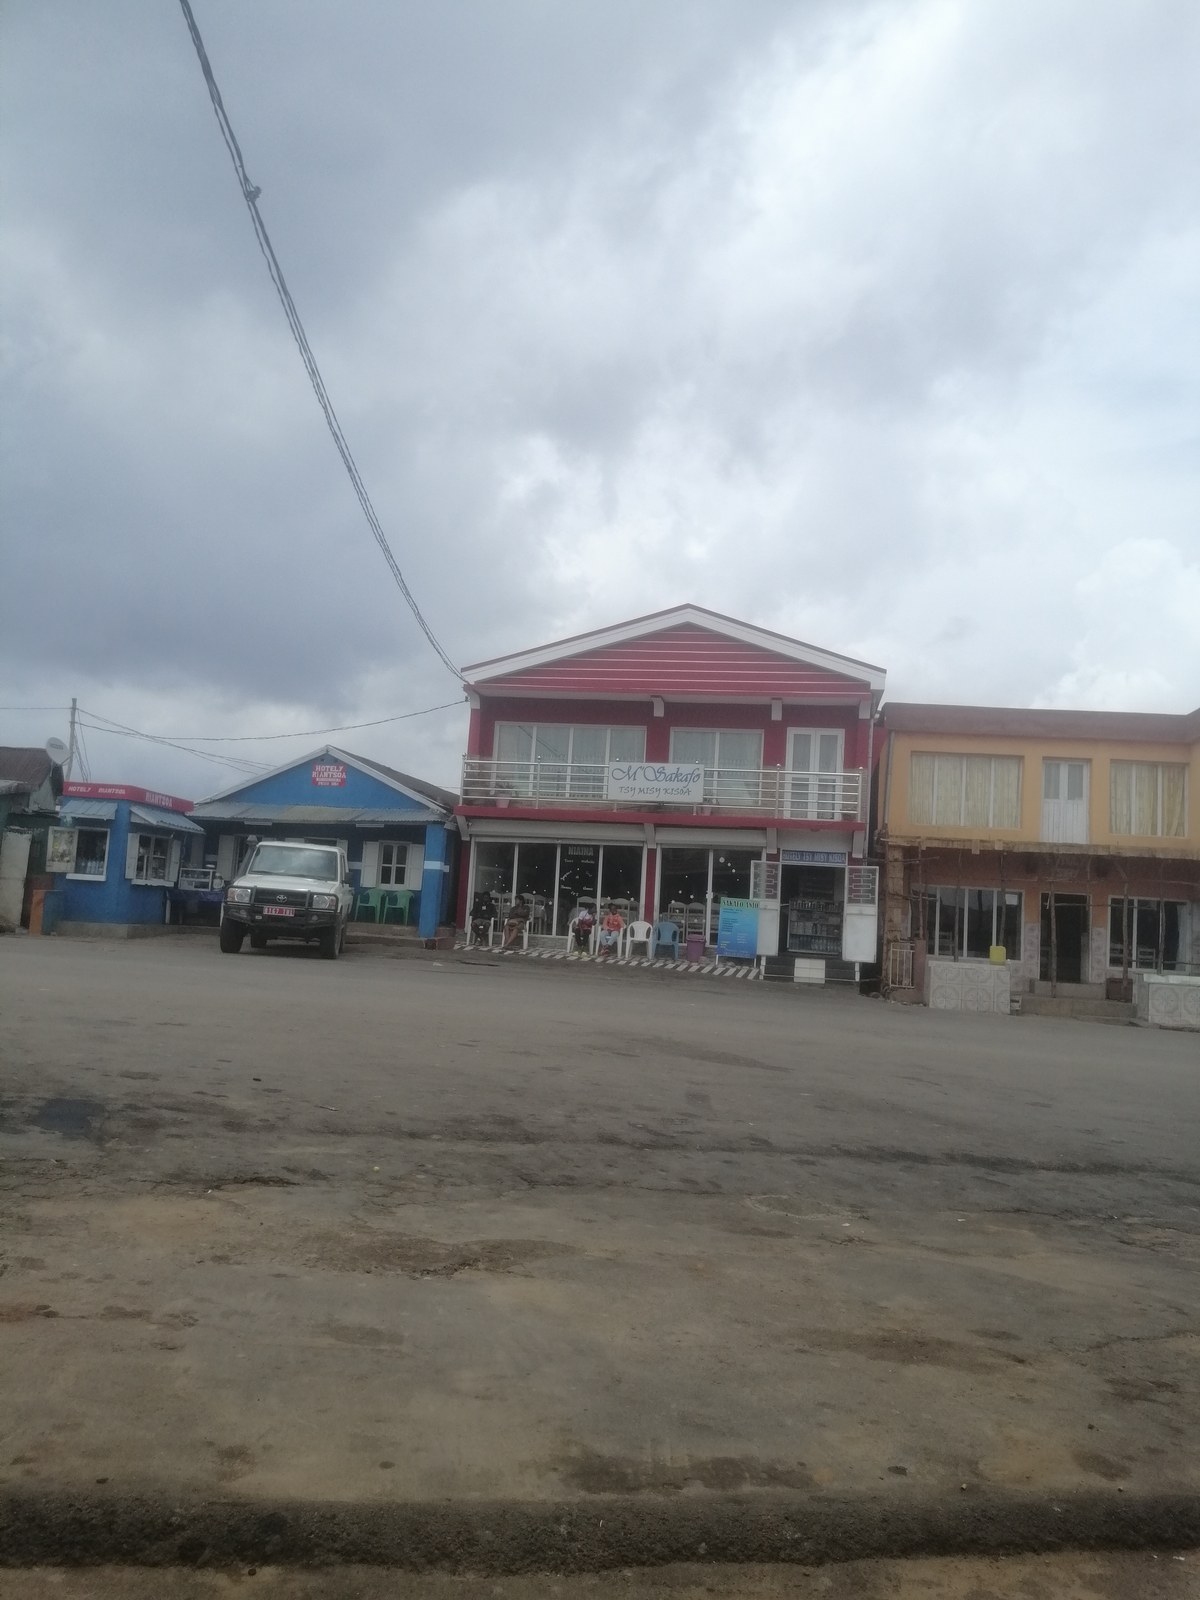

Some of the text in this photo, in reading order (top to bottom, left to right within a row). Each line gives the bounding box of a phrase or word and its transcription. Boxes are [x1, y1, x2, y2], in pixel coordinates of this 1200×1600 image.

[619, 786, 692, 798] TSY MISY KISOA
